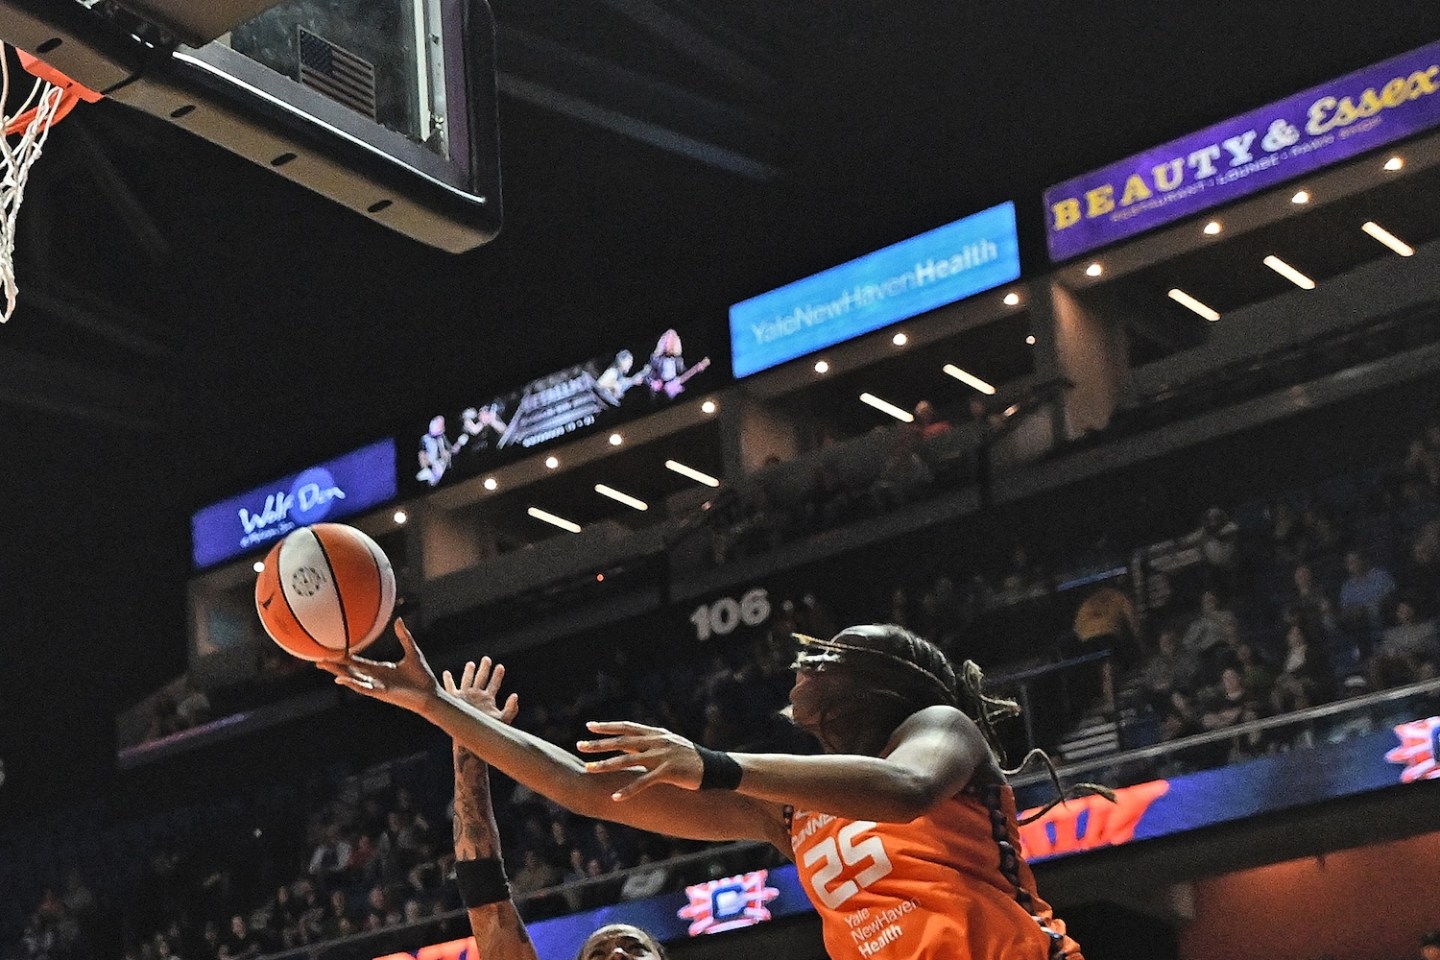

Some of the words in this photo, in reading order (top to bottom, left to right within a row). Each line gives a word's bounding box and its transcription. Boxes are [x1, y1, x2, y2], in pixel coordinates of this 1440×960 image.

[1050, 129, 1258, 231] BEAUTY
[1260, 118, 1301, 153] &
[1304, 64, 1440, 137] Essex
[689, 588, 771, 640] 106
[802, 819, 893, 911] 25
[844, 907, 871, 928] Yale
[850, 897, 922, 944] NewHaven
[857, 923, 903, 960] Health
